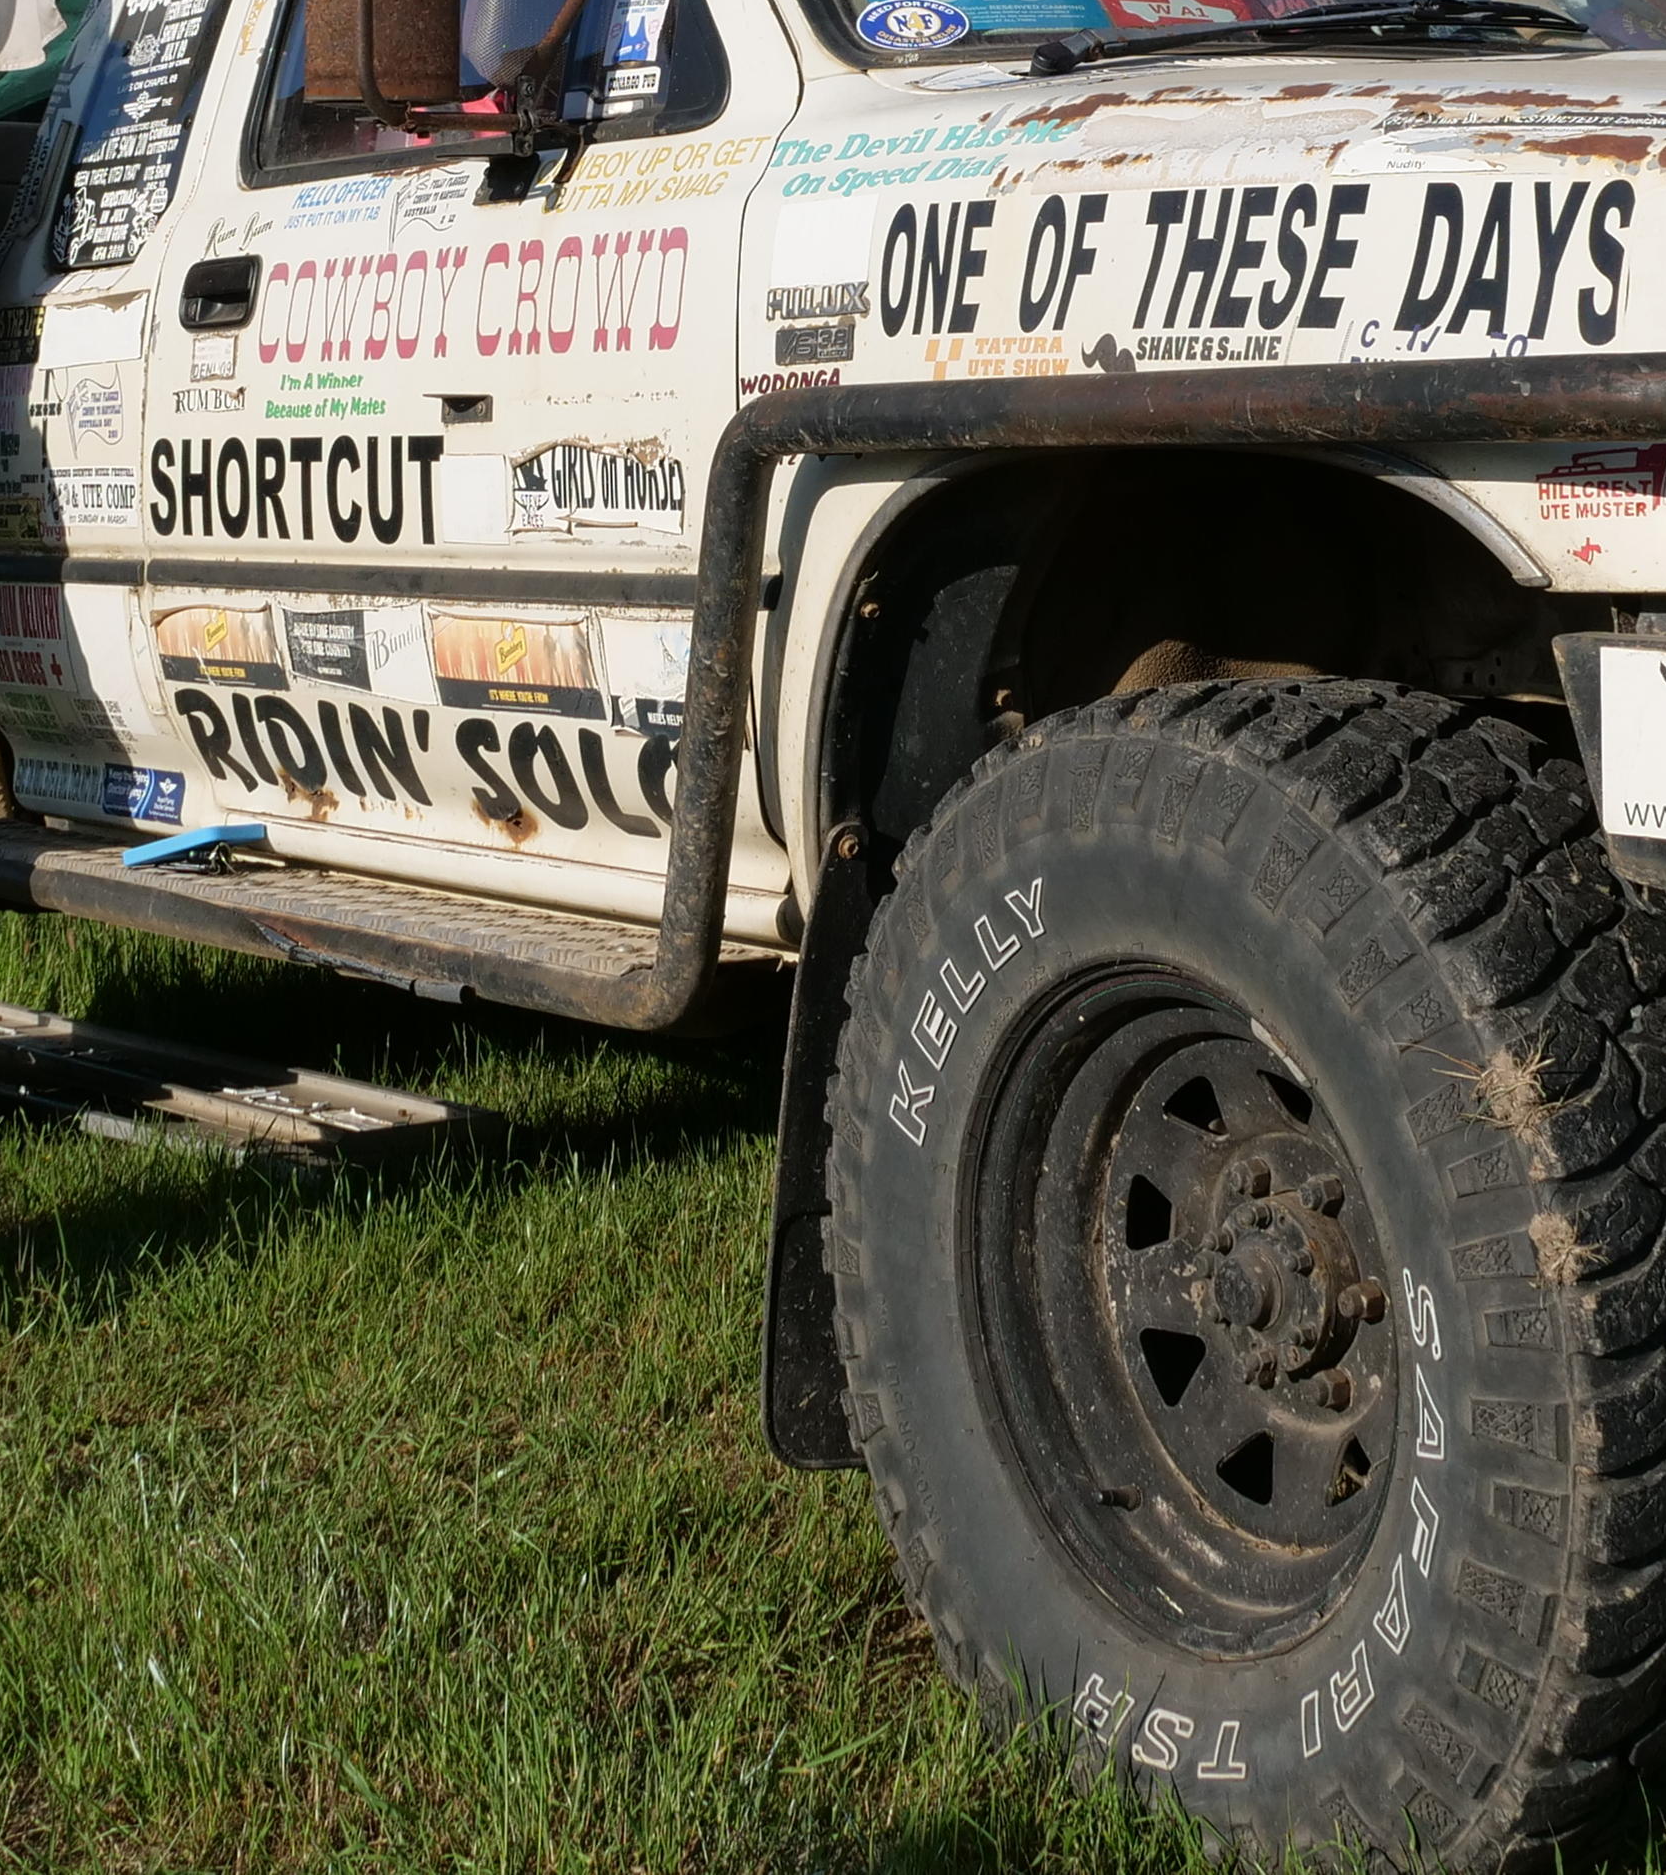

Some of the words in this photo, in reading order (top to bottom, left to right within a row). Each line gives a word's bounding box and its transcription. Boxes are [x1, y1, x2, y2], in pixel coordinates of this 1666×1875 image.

[867, 4, 895, 23] NEED
[895, 0, 927, 9] FOR
[929, 2, 956, 16] FEED
[636, 146, 673, 176] UP
[673, 140, 710, 173] OR
[713, 135, 773, 167] GET
[772, 135, 834, 169] The
[835, 128, 935, 161] Devil
[943, 121, 1010, 152] Has
[1009, 117, 1079, 149] Me
[781, 168, 834, 201] On
[834, 159, 928, 198] Speed
[928, 151, 1006, 183] Dial
[1386, 159, 1426, 171] Nudity
[292, 187, 336, 210] HELLO
[336, 176, 395, 202] OFFICER
[614, 179, 653, 207] MY
[654, 171, 731, 203] SWAG
[307, 210, 326, 228] PUT
[326, 210, 334, 226] IT
[333, 209, 348, 224] ON
[348, 208, 365, 224] MY
[364, 206, 383, 223] TAB
[403, 205, 438, 218] AUSTRALIA
[880, 199, 996, 338] ONE
[1017, 192, 1109, 334] OF
[1133, 180, 1370, 332] THESE
[1394, 177, 1636, 346] DAYS
[258, 245, 469, 364] COWBOY
[476, 226, 689, 358] CROWD
[975, 336, 1063, 355] TATURA
[967, 359, 1005, 377] UTE
[1013, 358, 1070, 376] SHOW
[280, 374, 301, 393] I'm
[303, 373, 315, 389] A
[316, 371, 365, 391] Winner
[741, 367, 841, 395] WODONGA
[174, 389, 212, 414] RUM
[265, 401, 314, 421] Because
[314, 400, 330, 419] of
[329, 400, 350, 422] My
[350, 398, 386, 417] Mates
[71, 492, 79, 509] &
[82, 484, 103, 509] UTE
[106, 484, 136, 509] COMP
[150, 434, 444, 545] SHORTCUT
[1538, 479, 1652, 501] HILLCREST
[107, 514, 129, 524] MARCH
[1540, 503, 1570, 520] UTE
[1576, 501, 1648, 519] MUSTER
[175, 688, 432, 807] RIDIN'
[889, 877, 1047, 1147] KELLY
[1301, 1266, 1445, 1760] SAFARI
[1071, 1672, 1249, 1782] TSR
